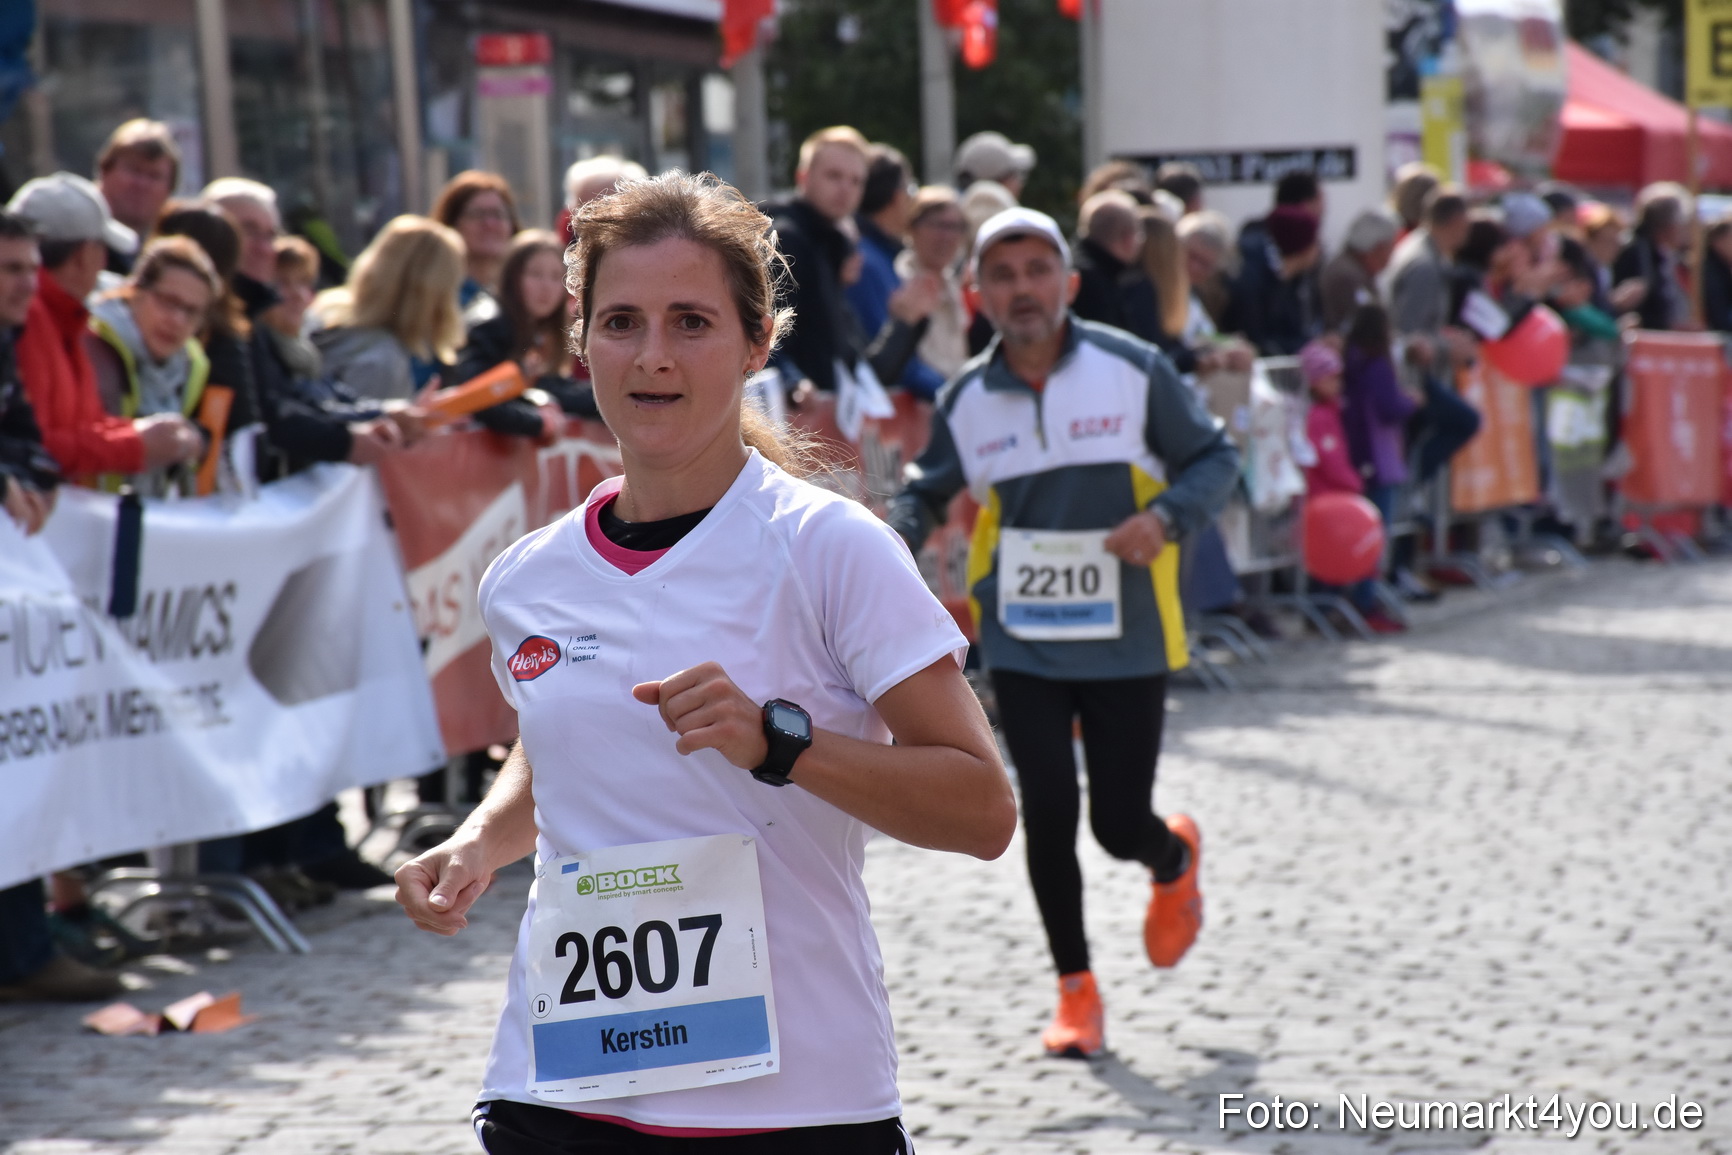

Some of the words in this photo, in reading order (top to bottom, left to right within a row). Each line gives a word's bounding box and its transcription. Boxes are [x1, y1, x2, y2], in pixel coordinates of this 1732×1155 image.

[1017, 564, 1100, 597] 2210
[576, 634, 597, 642] STORE
[511, 646, 557, 672] Hervis
[572, 654, 597, 663] MOBILE
[596, 864, 682, 893] BOCK
[598, 890, 622, 901] inspired
[632, 888, 652, 896] smart
[653, 885, 684, 893] concepts
[555, 913, 723, 1005] 2607
[601, 1020, 688, 1054] Kerstin
